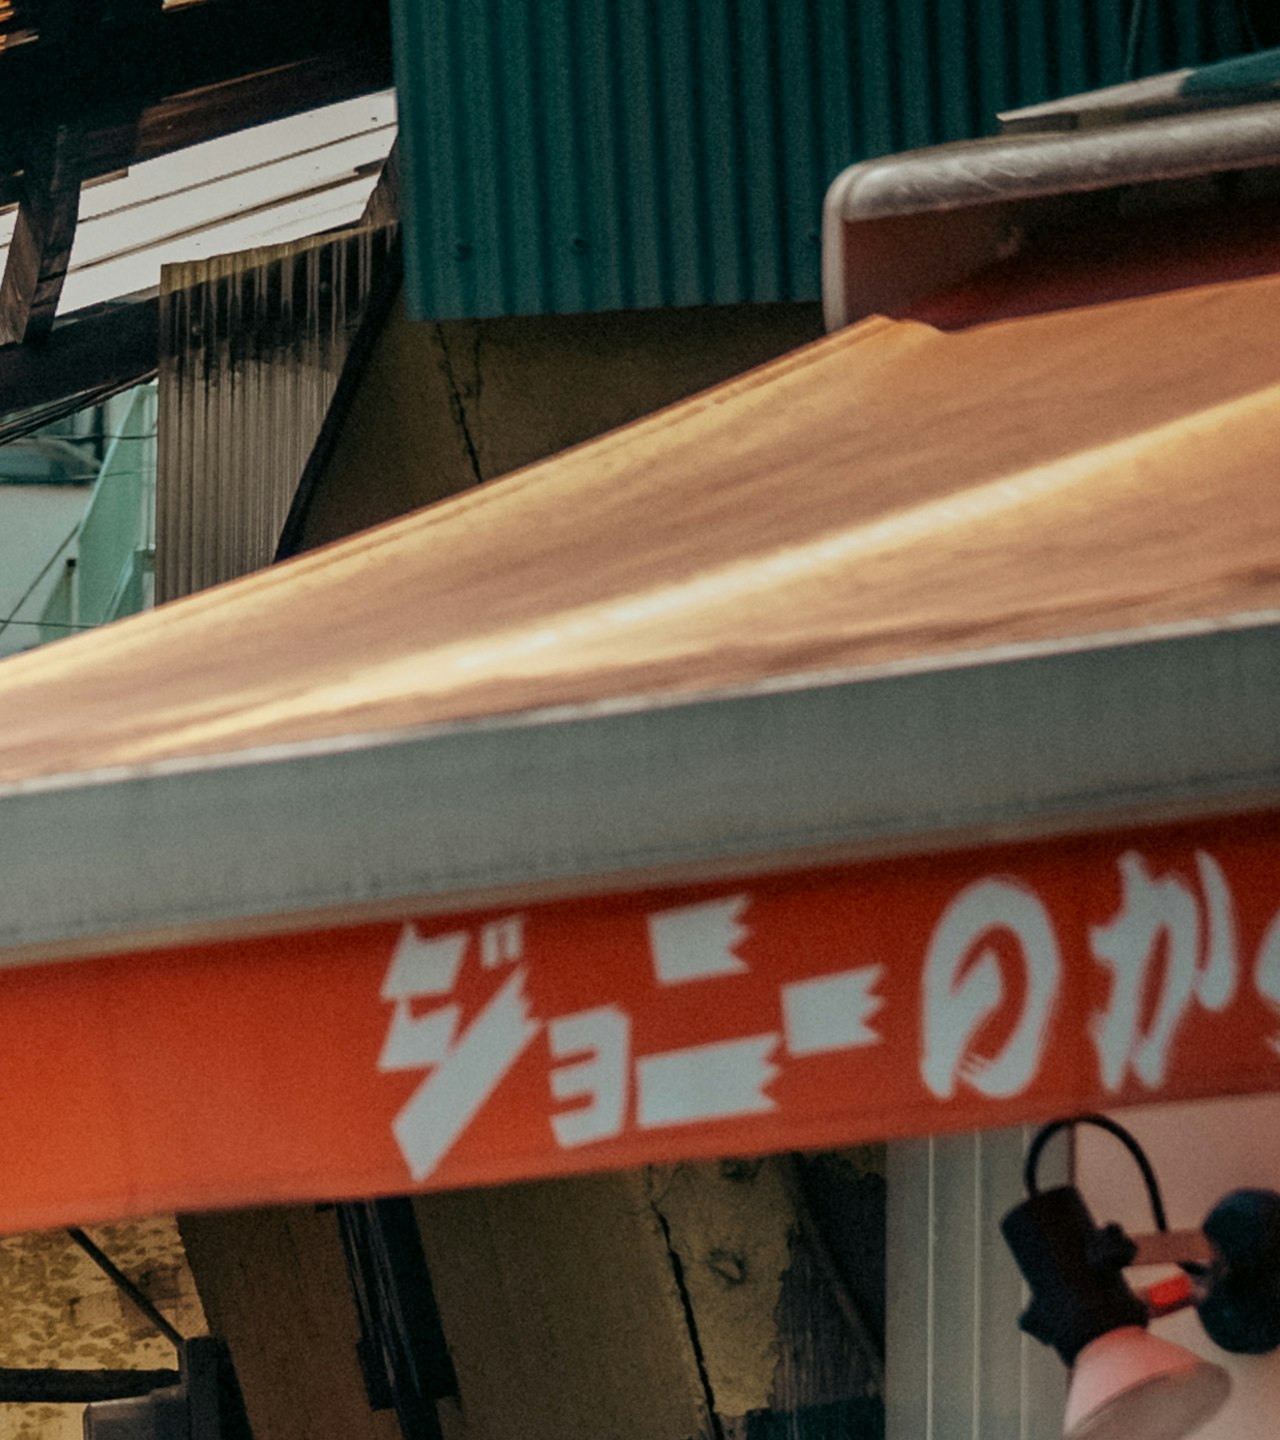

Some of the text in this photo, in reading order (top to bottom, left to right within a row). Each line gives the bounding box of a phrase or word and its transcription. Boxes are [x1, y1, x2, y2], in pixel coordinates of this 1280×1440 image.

[378, 852, 1280, 1184] ジョニーのか
